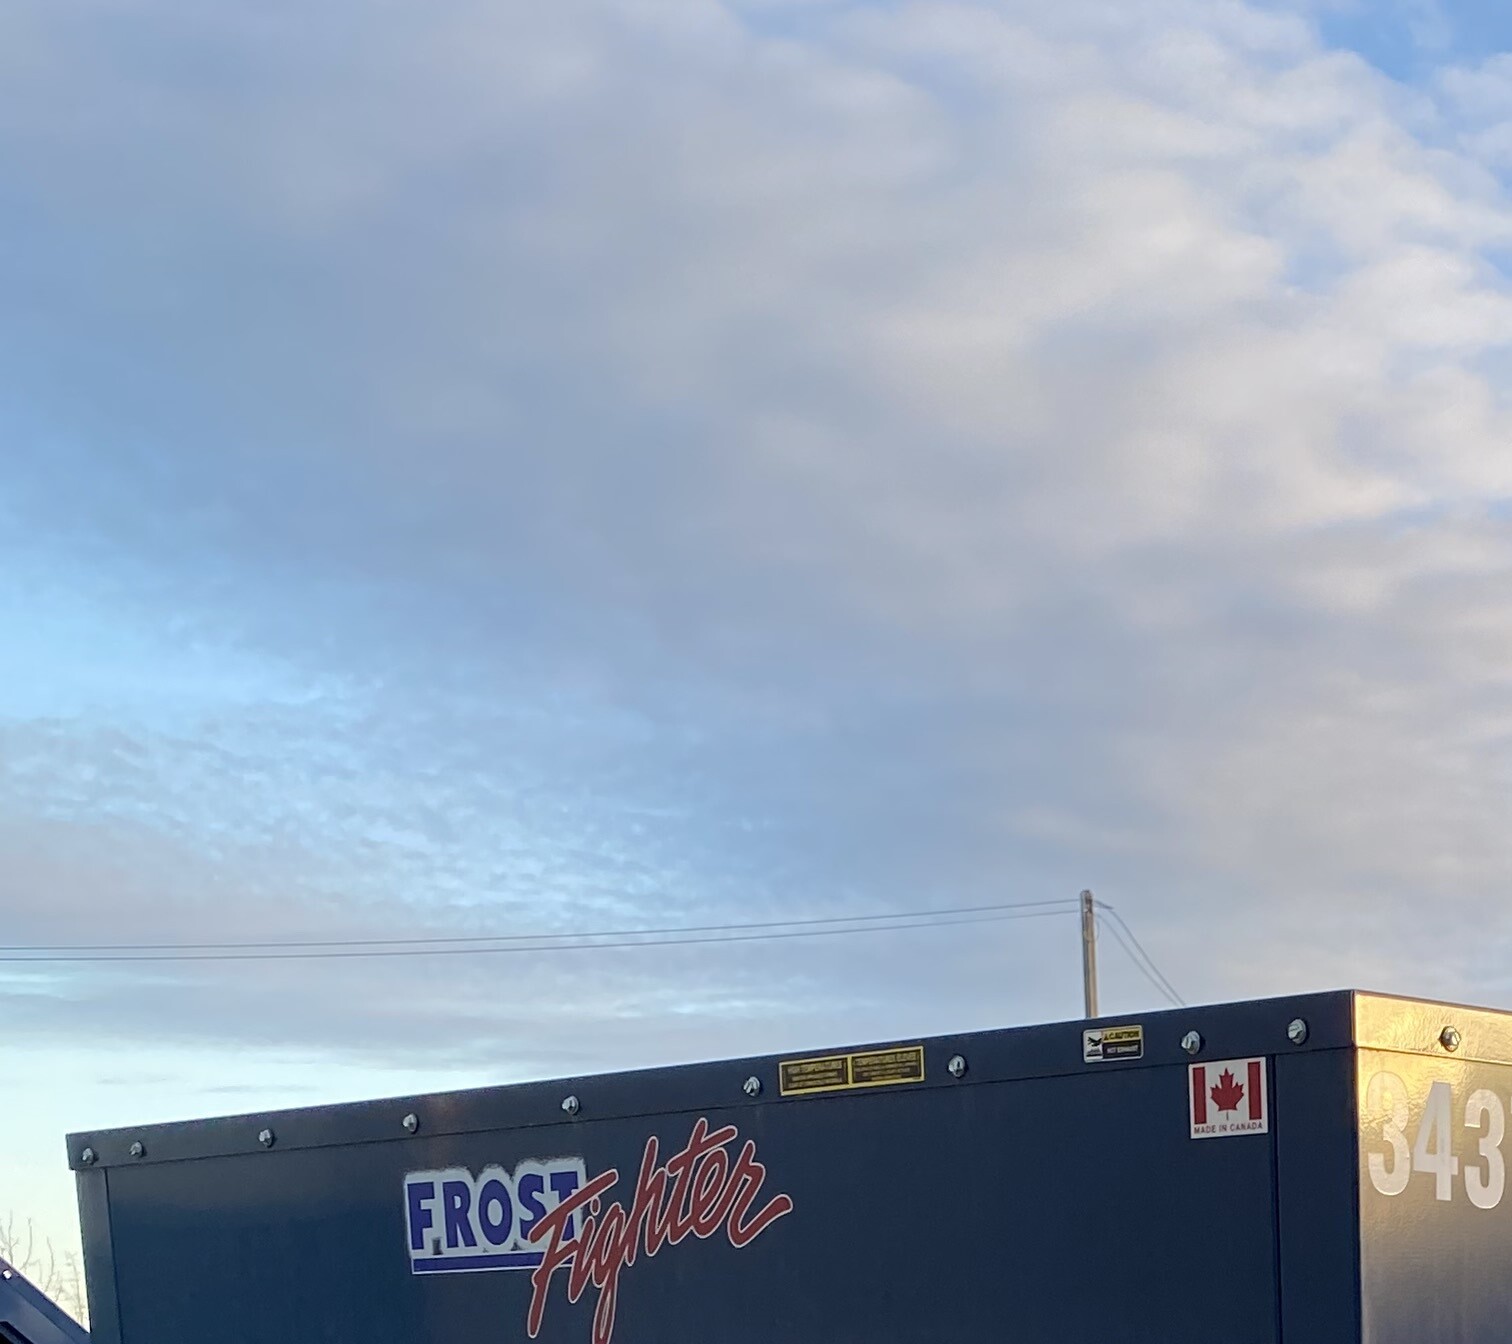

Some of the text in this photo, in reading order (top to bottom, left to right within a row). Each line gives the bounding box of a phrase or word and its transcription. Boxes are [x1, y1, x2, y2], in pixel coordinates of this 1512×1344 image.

[1194, 1122, 1263, 1135] MADE IN CANADA
[407, 1171, 580, 1250] FROST
